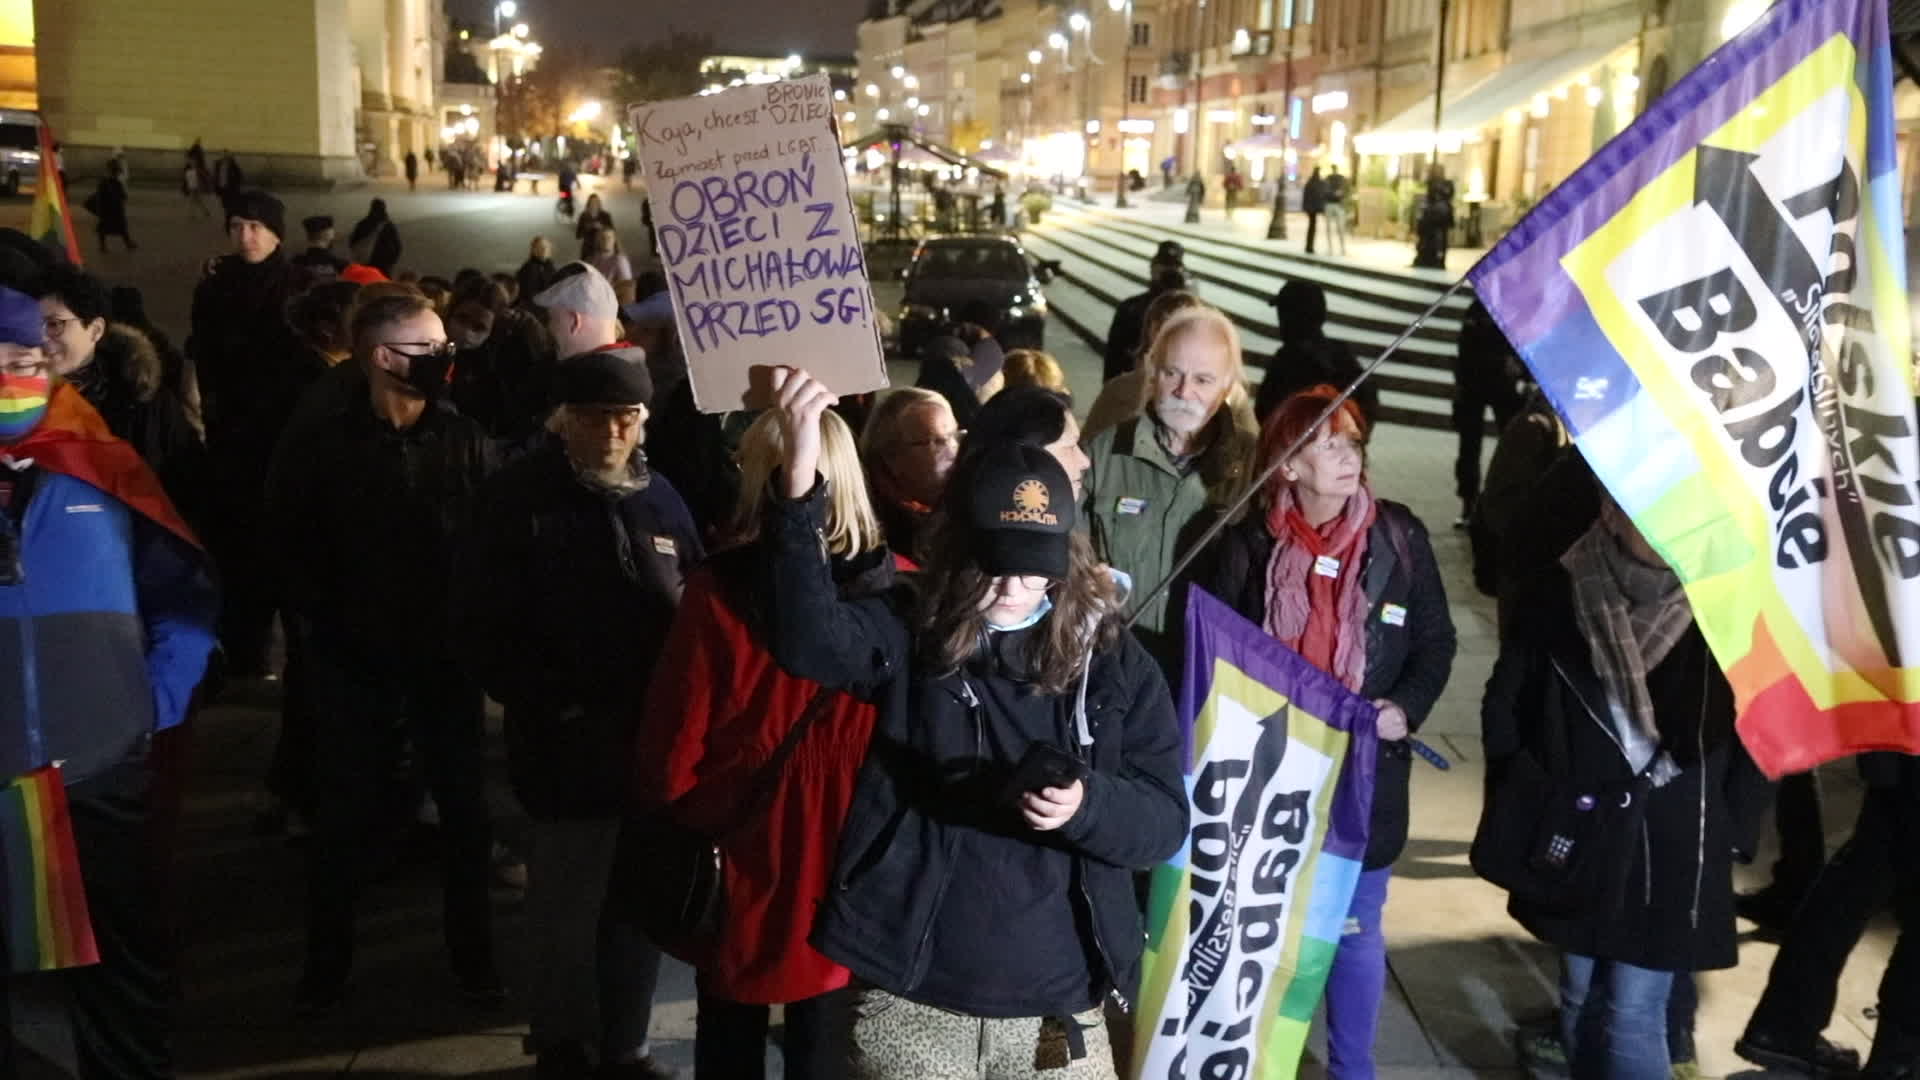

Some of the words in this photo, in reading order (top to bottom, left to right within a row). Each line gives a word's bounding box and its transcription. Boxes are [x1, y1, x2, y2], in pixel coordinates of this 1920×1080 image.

[671, 154, 815, 225] OBROŃ
[658, 211, 780, 266] DZIECI
[804, 202, 841, 241] Z
[685, 299, 801, 353] PRZED
[810, 287, 867, 329] SG!
[1637, 267, 1828, 570] Babcie
